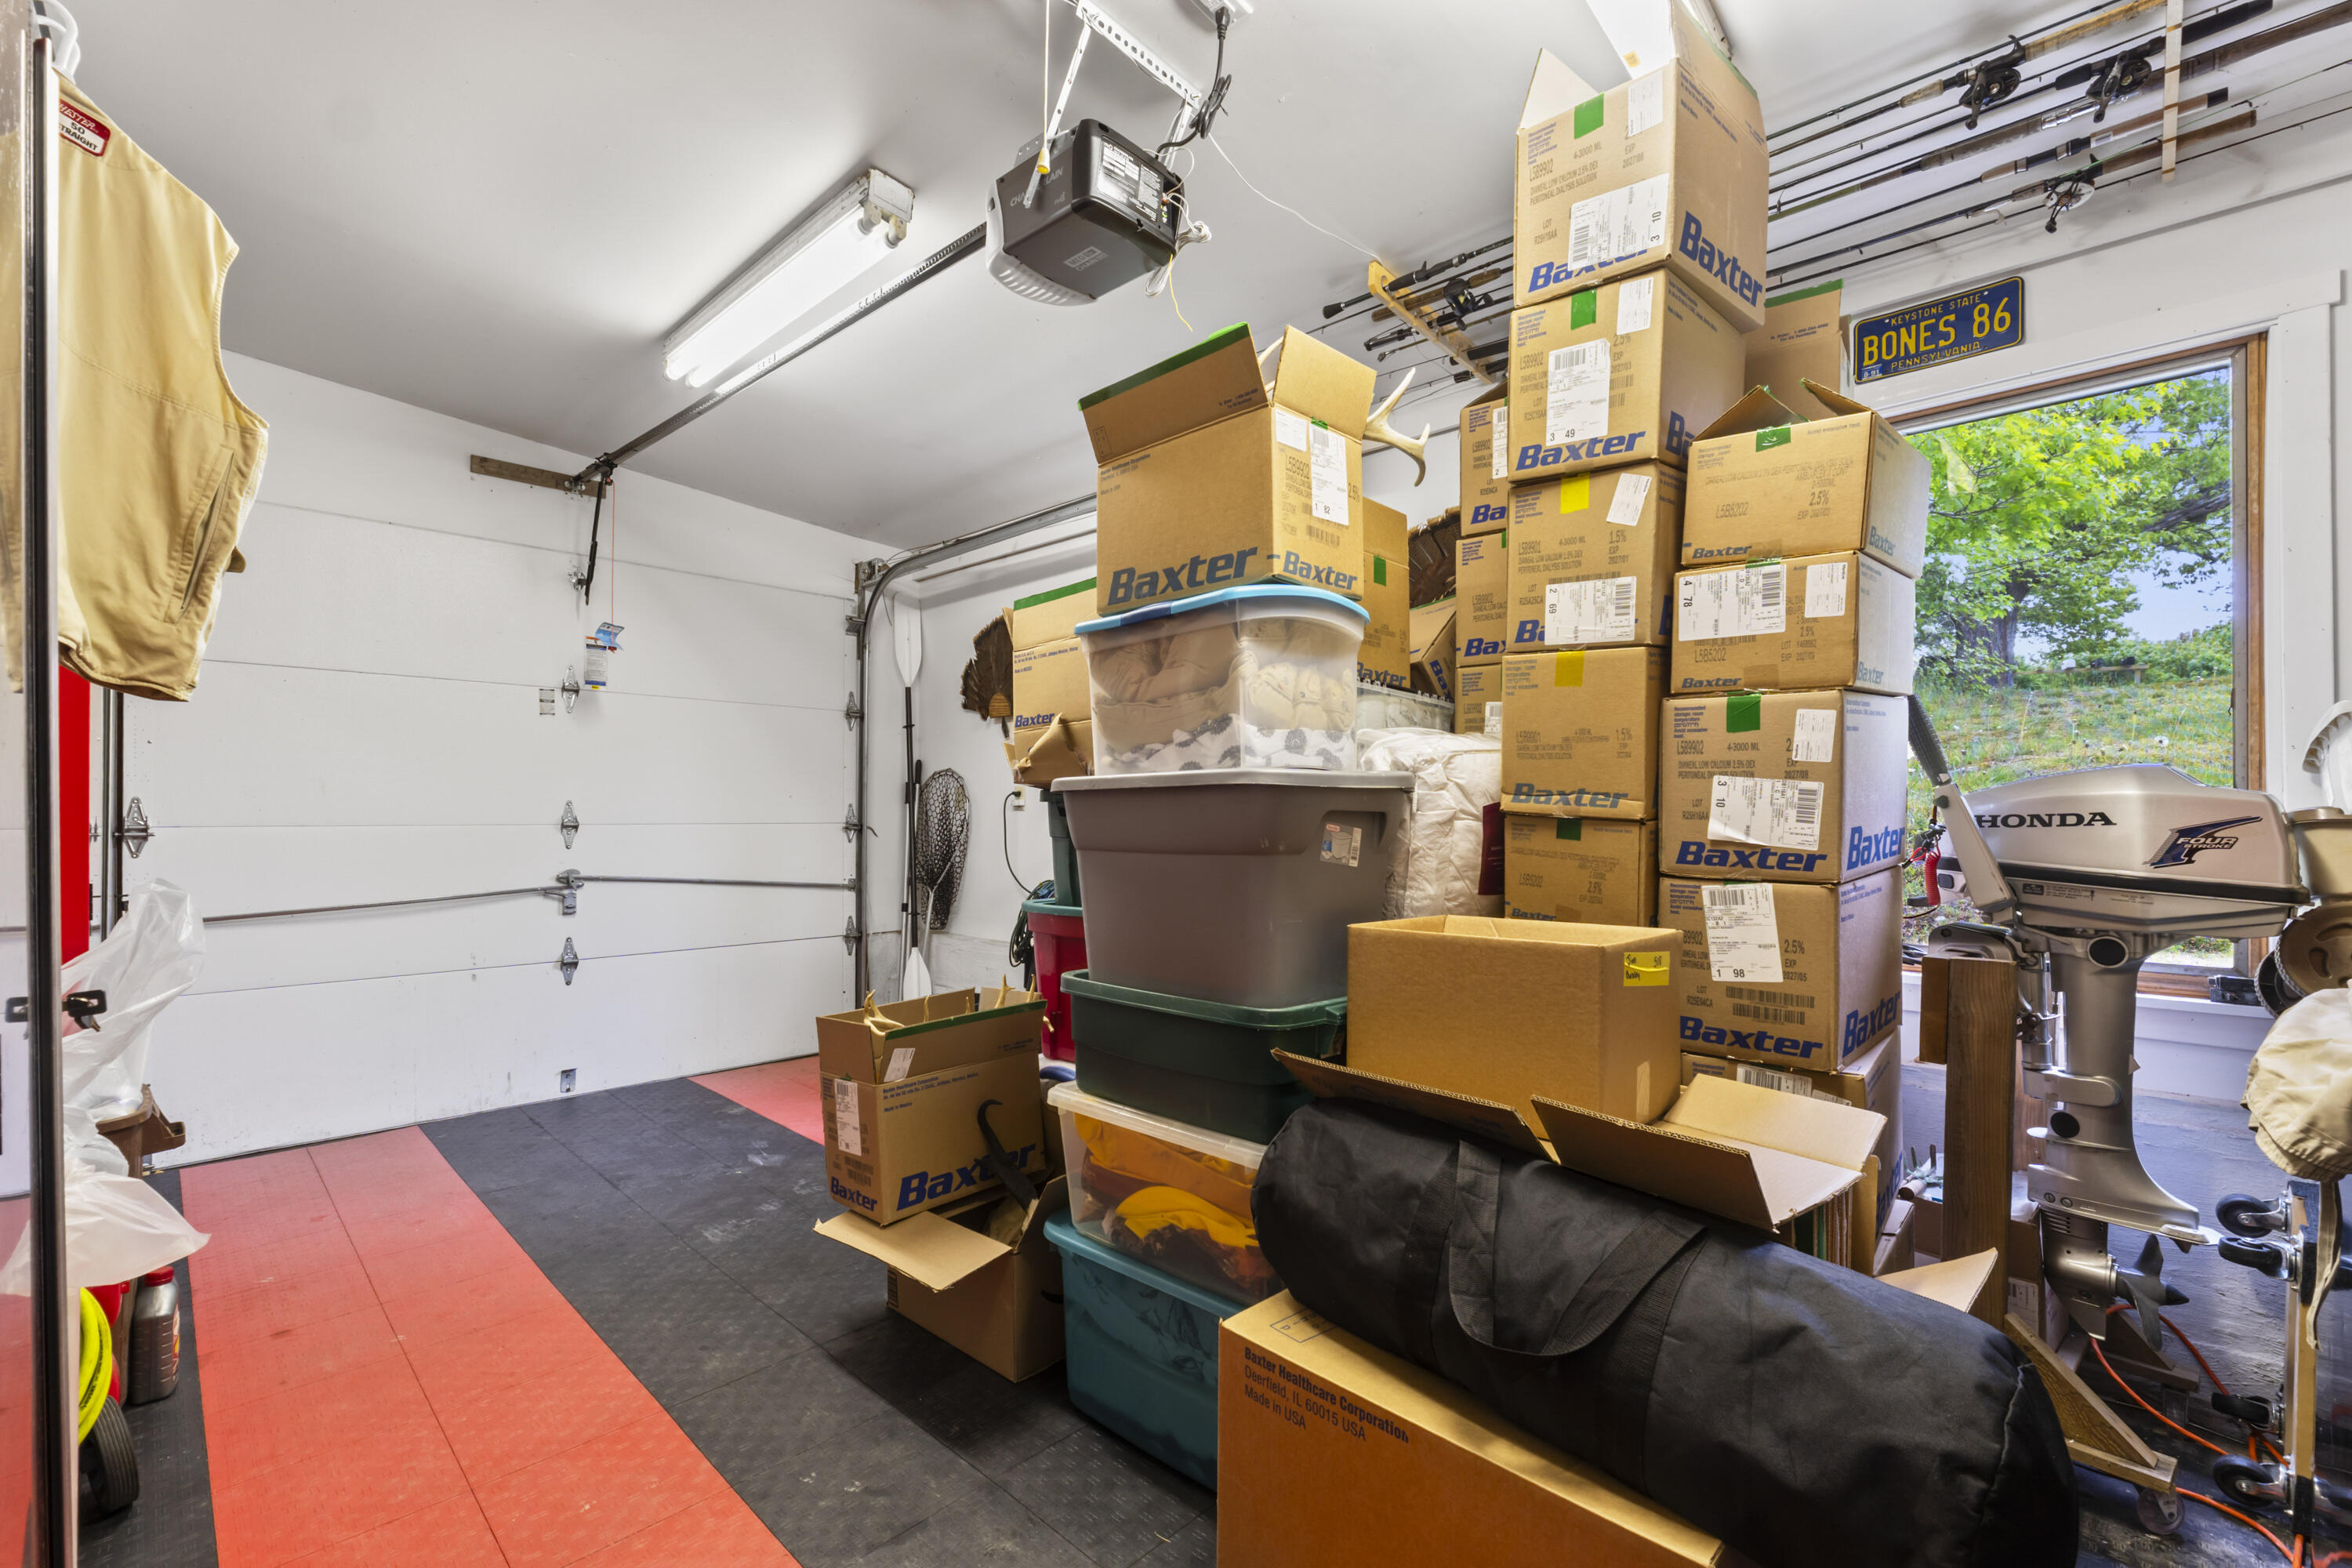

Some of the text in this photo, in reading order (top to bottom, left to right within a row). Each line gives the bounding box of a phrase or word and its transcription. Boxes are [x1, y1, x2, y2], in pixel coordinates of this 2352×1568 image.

[1624, 143, 1635, 155] EXP
[1543, 219, 1552, 230] LOT
[1652, 211, 1661, 223] 10
[1679, 210, 1763, 308] Baxter
[1529, 249, 1648, 293] Bax
[1890, 293, 1981, 326] KEYSTONE STATE
[1863, 297, 2012, 366] BONES 86
[1613, 351, 1623, 361] EXP
[1891, 341, 1980, 370] PENNSYLVANIA
[1534, 397, 1543, 407] LOT
[1550, 429, 1575, 441] 3 49
[1515, 431, 1646, 471] Baxter
[1809, 490, 1830, 507] 2.5%
[1715, 502, 1749, 519] L5B5202
[1798, 511, 1809, 520] EXP
[1609, 529, 1627, 544] 1.5%
[1869, 525, 1896, 557] Baxter
[1609, 546, 1619, 555] EXP
[1692, 546, 1753, 559] Baxter
[1107, 547, 1258, 606] Baxter
[1283, 550, 1358, 591] Baxter
[1528, 583, 1537, 593] LOT
[1683, 596, 1693, 608] 78
[1800, 626, 1815, 637] 2.5%
[1781, 641, 1791, 650] LOT
[1694, 648, 1726, 663] L5B5202
[1781, 653, 1792, 662] EXP
[1429, 659, 1452, 699] Bax
[1858, 661, 1884, 684] Baxter
[1682, 677, 1742, 688] Baxter
[1014, 713, 1055, 728] Baxter
[1615, 728, 1633, 742] 1.5%
[1677, 740, 1704, 755] L5B9902
[1751, 742, 1760, 751] ML
[1733, 760, 1745, 769] 2.5%
[1787, 758, 1798, 768] EXP
[1678, 771, 1706, 779] PERITONEAL
[1511, 782, 1629, 809] Baxter
[1715, 797, 1726, 808] 10
[1692, 799, 1703, 808] LOT
[1974, 811, 2118, 829] HONDA
[1675, 840, 1827, 872] Baxter
[1846, 826, 1906, 871] Baxter
[1512, 908, 1557, 921] Baxter
[1683, 930, 1703, 946] B9902
[1784, 939, 1806, 955] 2.5%
[1681, 959, 1706, 971] ERITONEAL
[1784, 959, 1797, 968] EXP
[1717, 968, 1745, 978] 1 98
[1697, 985, 1708, 994] LOT
[1842, 990, 1901, 1058] Baxter
[1680, 1015, 1823, 1058] Baxter
[830, 1176, 877, 1212] Baxter
[1244, 1346, 1410, 1443] Baxter Healthcare Corporation
[1244, 1365, 1367, 1442] Deerfield, IL 60015 USA
[1244, 1385, 1306, 1431] Made in USA
